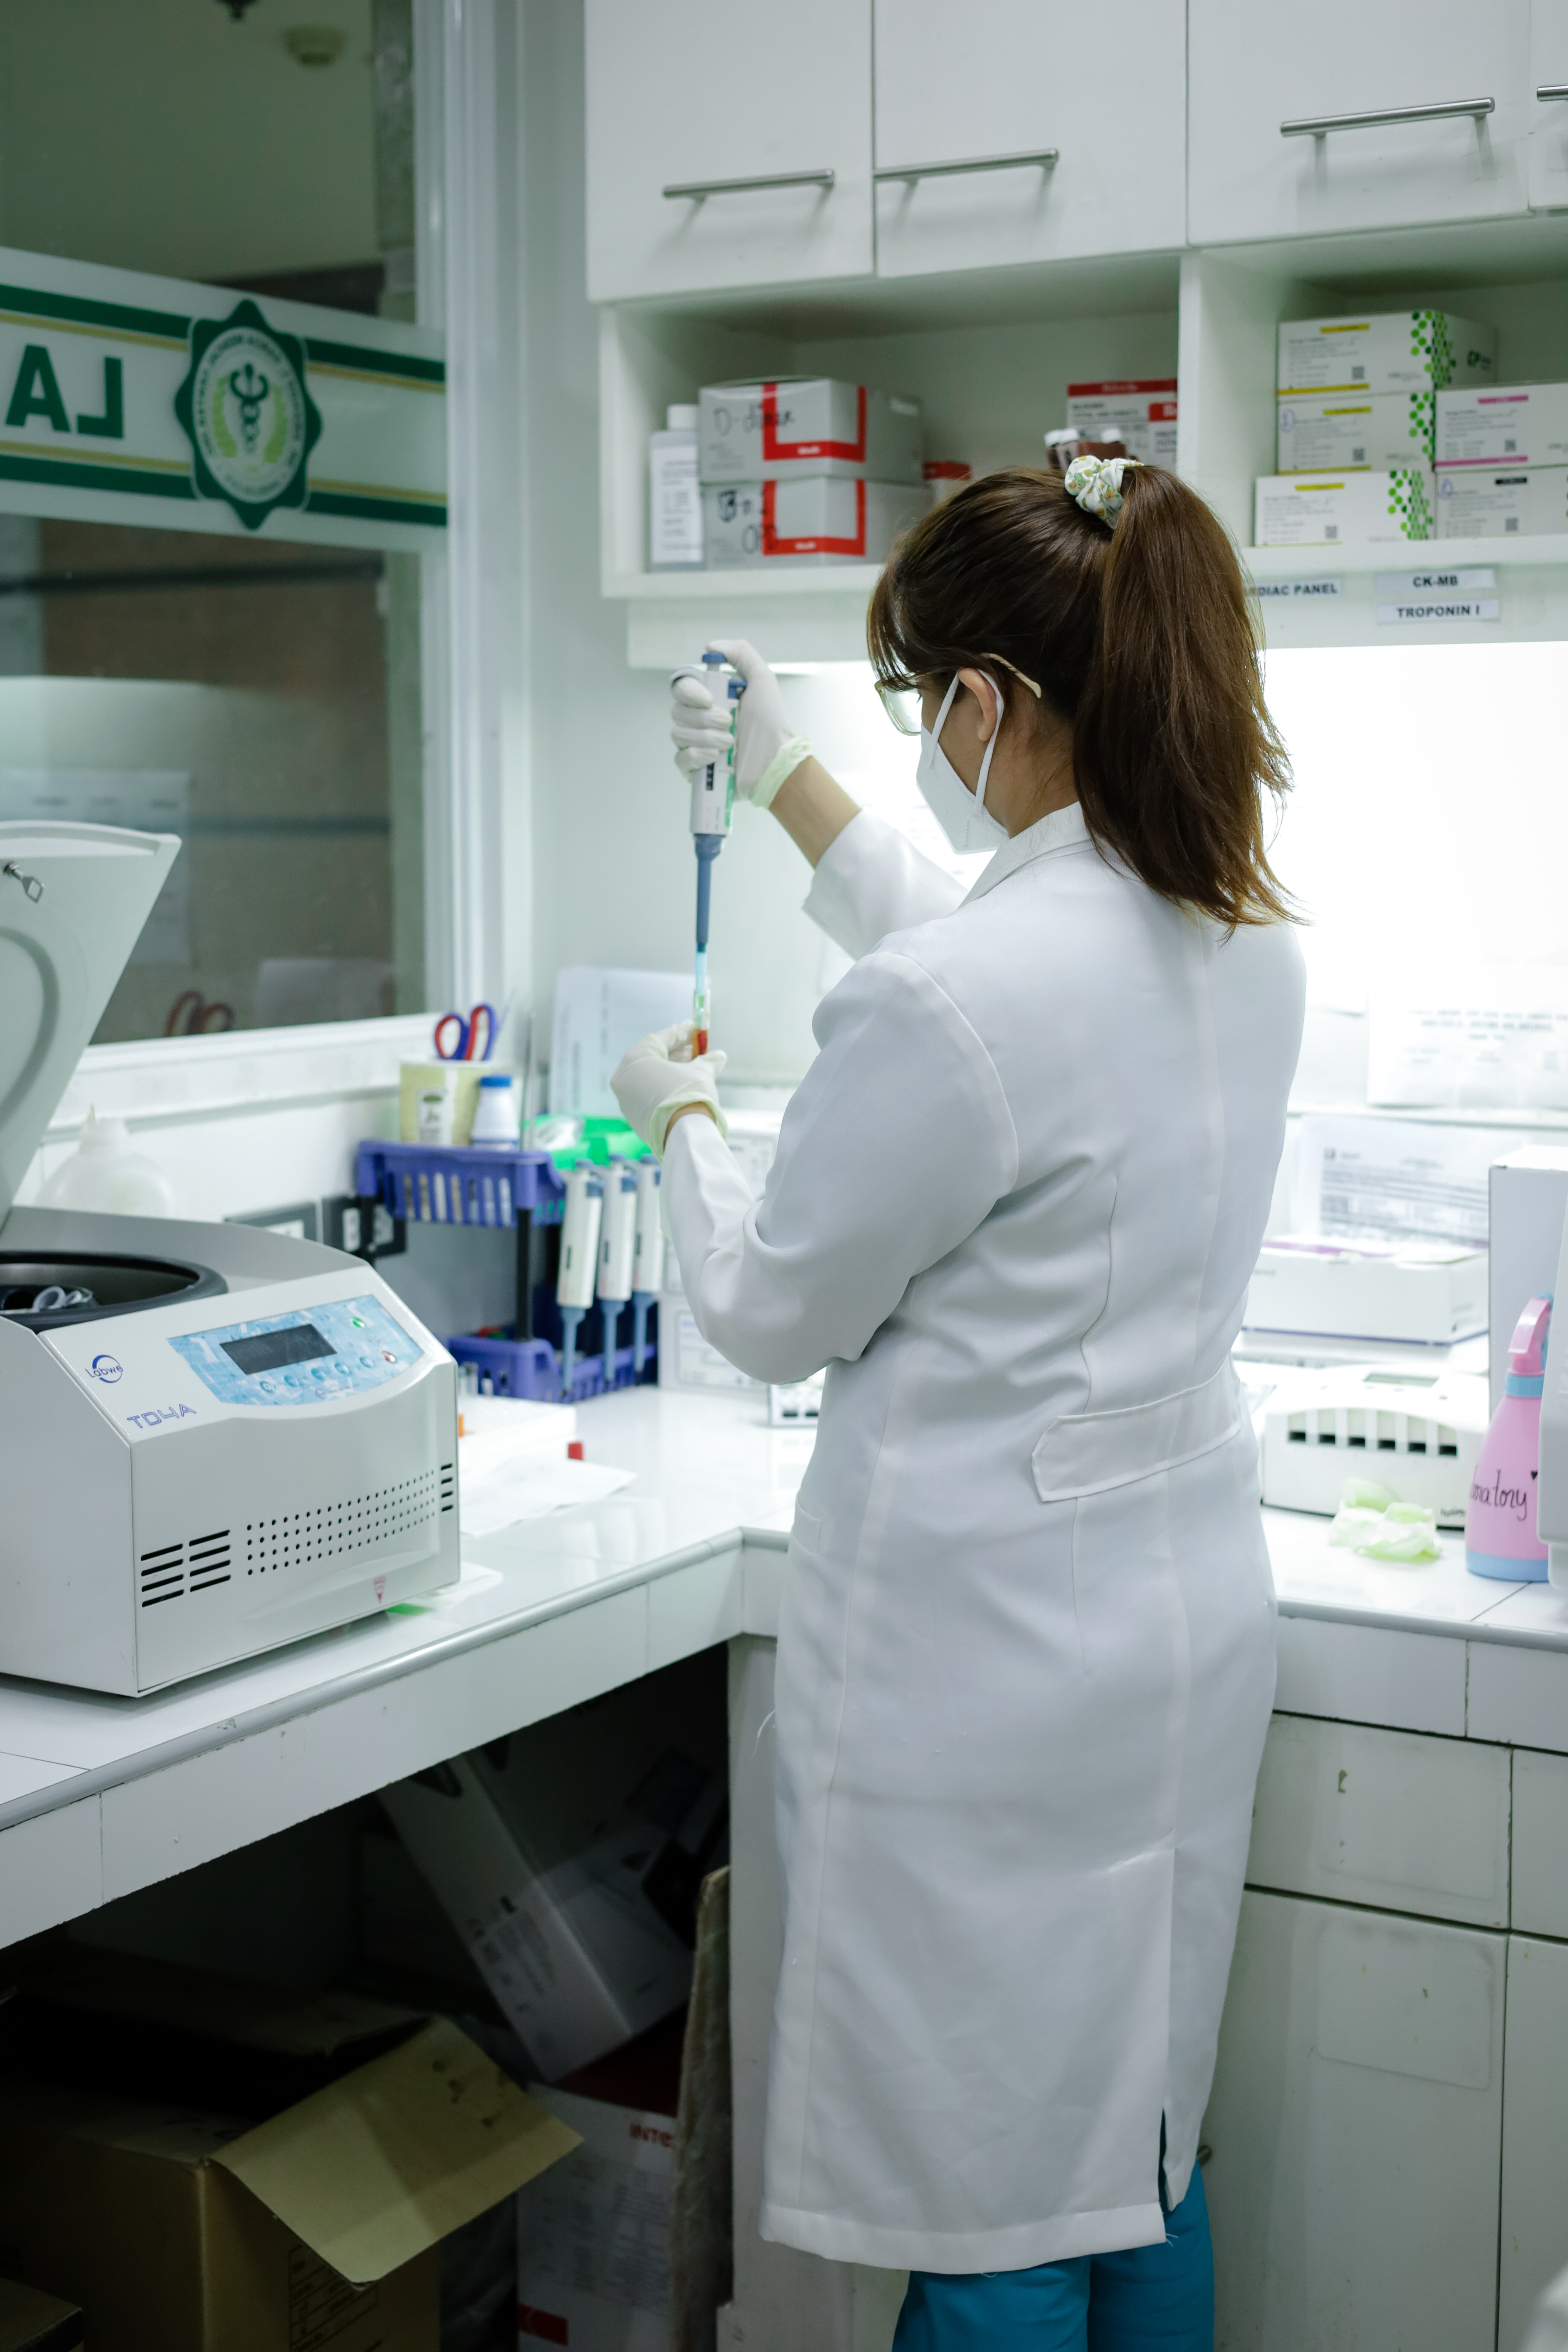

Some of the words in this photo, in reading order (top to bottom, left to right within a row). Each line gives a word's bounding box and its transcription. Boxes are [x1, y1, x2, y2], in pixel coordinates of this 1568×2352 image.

[1413, 575, 1459, 587] CK-MB
[1293, 583, 1338, 595] PANEL
[1397, 604, 1470, 618] TROPONIN
[1475, 604, 1480, 615] I
[84, 1365, 124, 1378] Labwe
